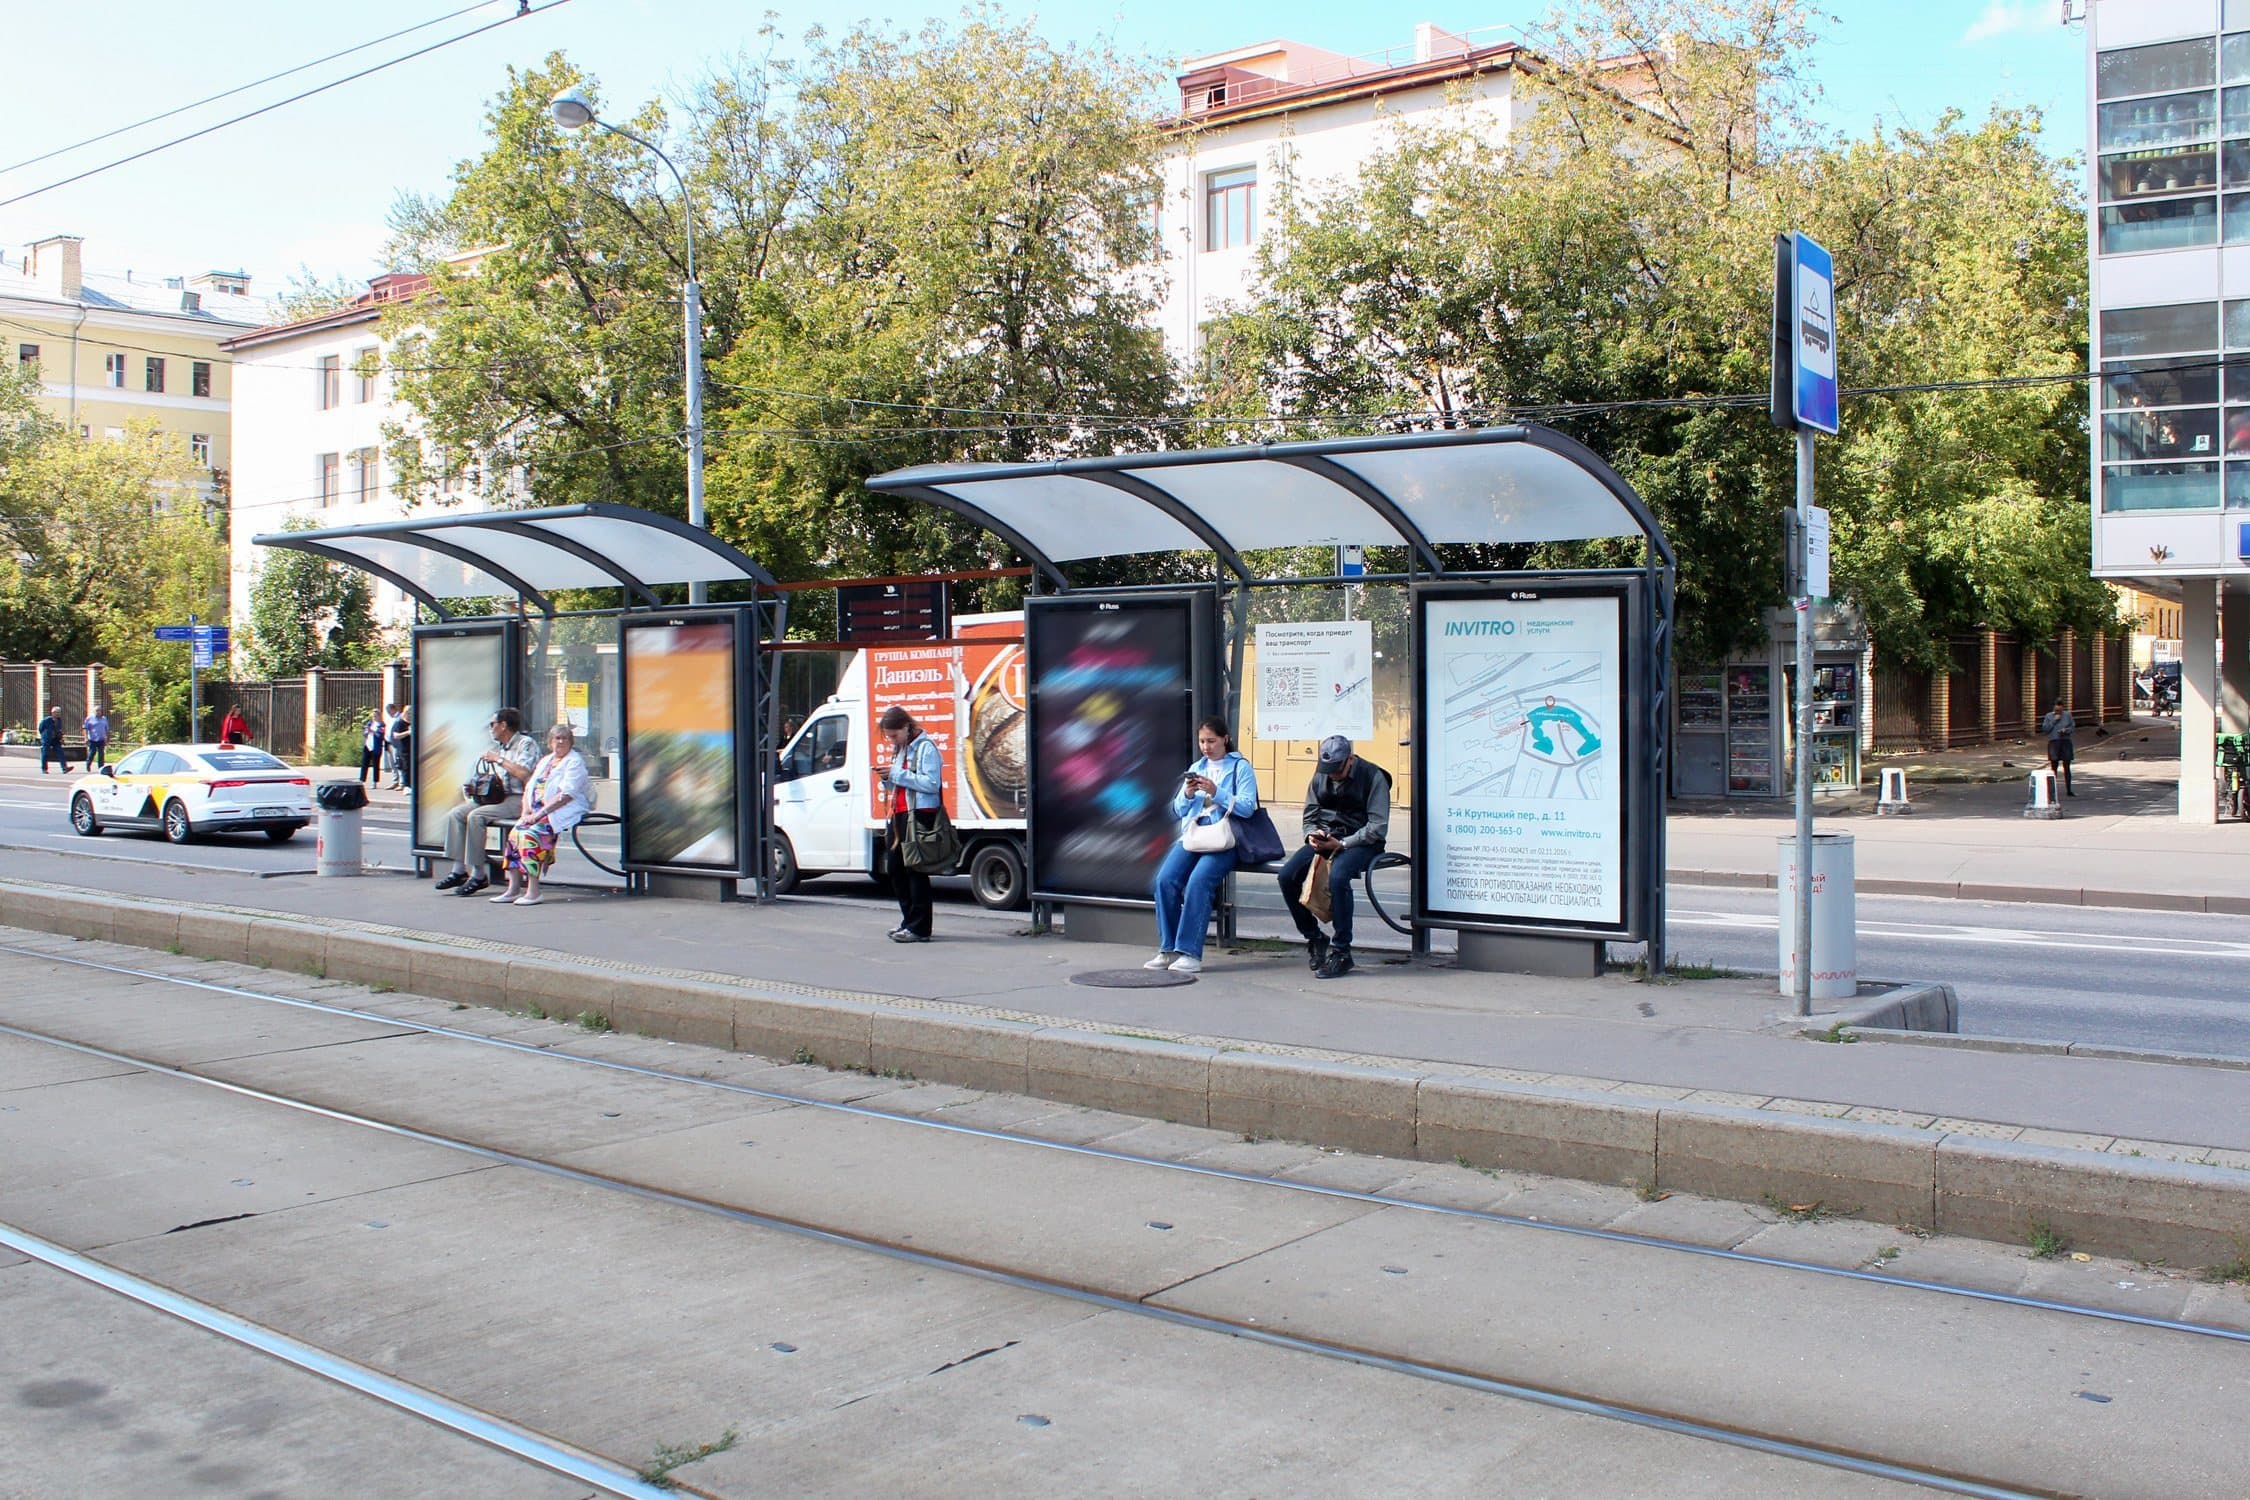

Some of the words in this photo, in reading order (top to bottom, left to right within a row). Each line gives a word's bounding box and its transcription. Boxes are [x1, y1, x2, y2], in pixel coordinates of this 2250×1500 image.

[1445, 620, 1515, 636] INVITRO
[874, 651, 909, 662] ГРУППА
[874, 666, 943, 688] Даниэль
[1447, 807, 1462, 817] 3-й
[1464, 808, 1516, 821] Крутицкий
[1517, 811, 1540, 822] пер.,
[1542, 813, 1551, 821] д.
[1555, 811, 1566, 821] 11
[1447, 825, 1452, 833] 8
[1455, 824, 1477, 835] (800)
[1541, 828, 1602, 839] www.invitro.ru
[1446, 877, 1479, 889] ИМЕЮТСЯ
[1555, 883, 1602, 895] НЕОБХОДИМО
[1447, 889, 1488, 902] ПОЛУЧЕНИЕ
[1490, 892, 1547, 905] КОНСУЛЬТАЦИИ
